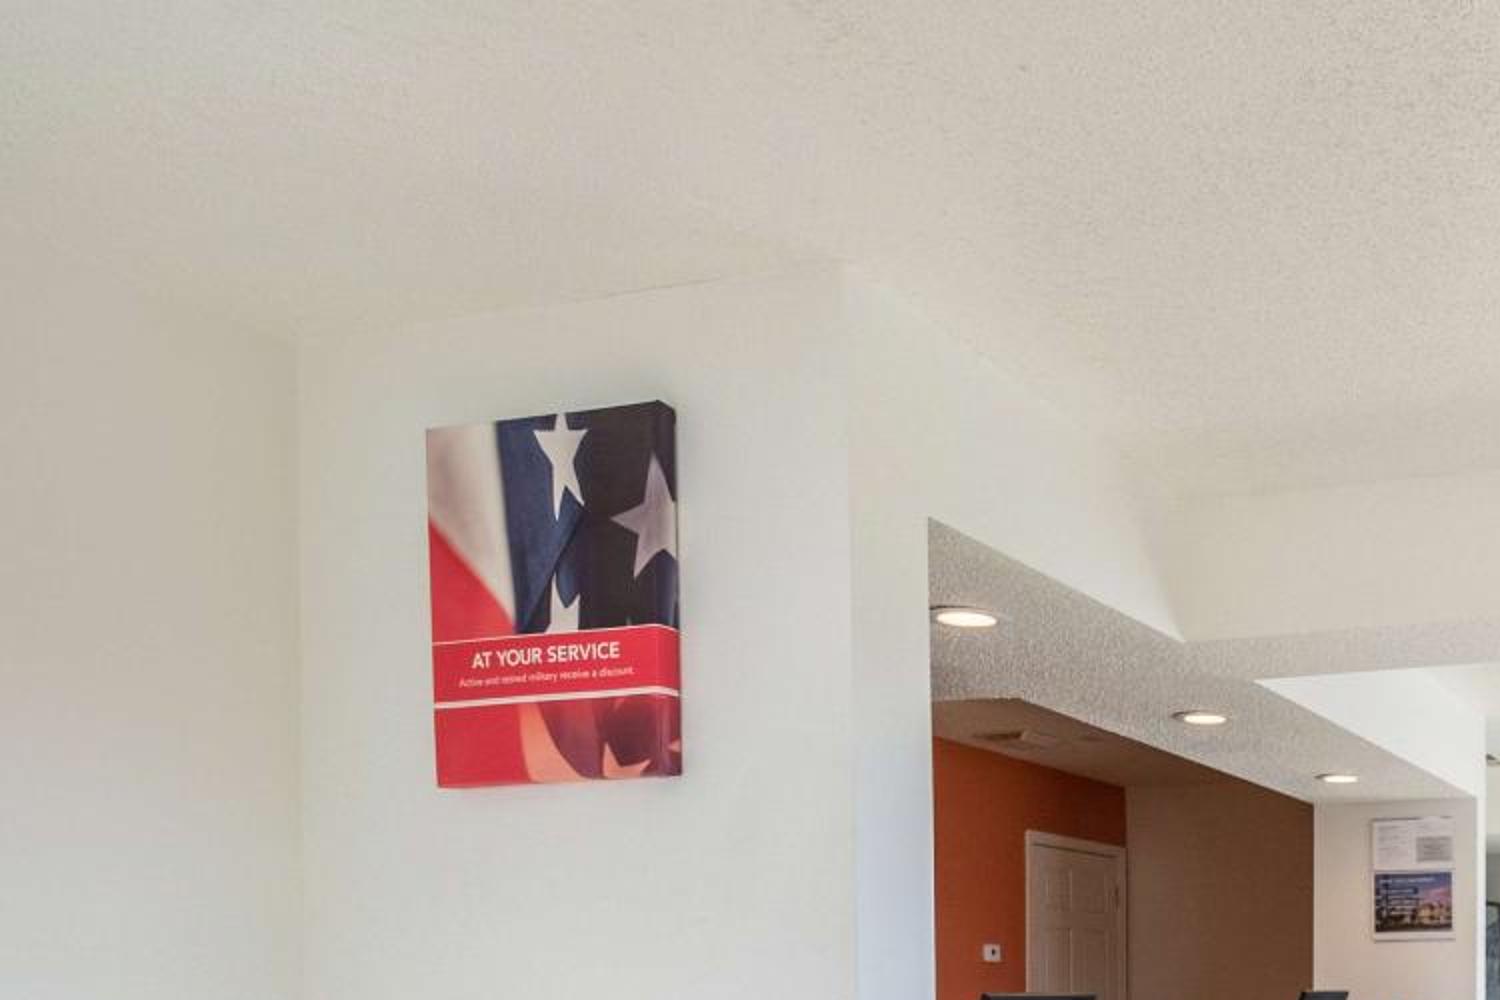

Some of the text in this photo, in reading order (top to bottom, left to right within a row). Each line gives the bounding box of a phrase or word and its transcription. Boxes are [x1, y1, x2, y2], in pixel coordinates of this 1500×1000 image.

[472, 641, 620, 669] AT YOUR SERVICE
